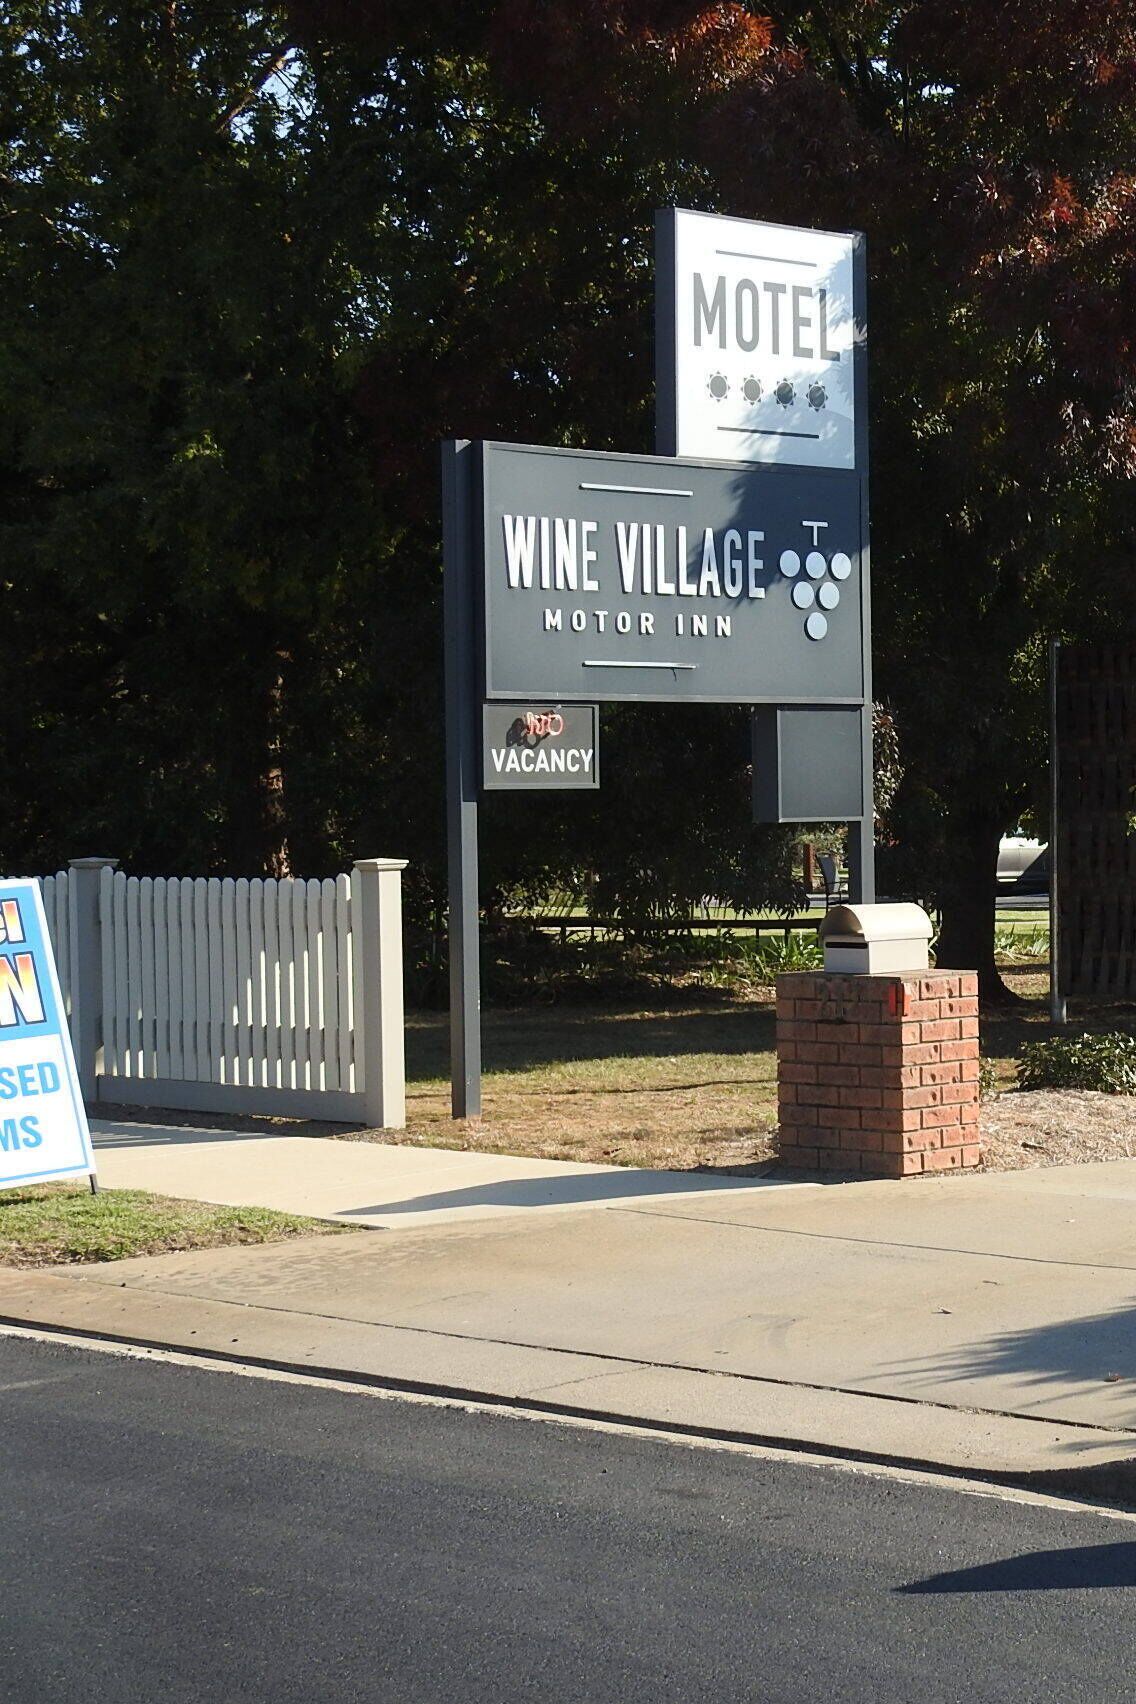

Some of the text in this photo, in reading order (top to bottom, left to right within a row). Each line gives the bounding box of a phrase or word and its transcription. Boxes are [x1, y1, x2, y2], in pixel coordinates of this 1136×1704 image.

[693, 272, 840, 362] MOTEL
[503, 514, 766, 599] WINE VILLAGE
[544, 608, 731, 637] MOTOR INN
[491, 748, 593, 773] VACANCY
[0, 1061, 61, 1100] SED
